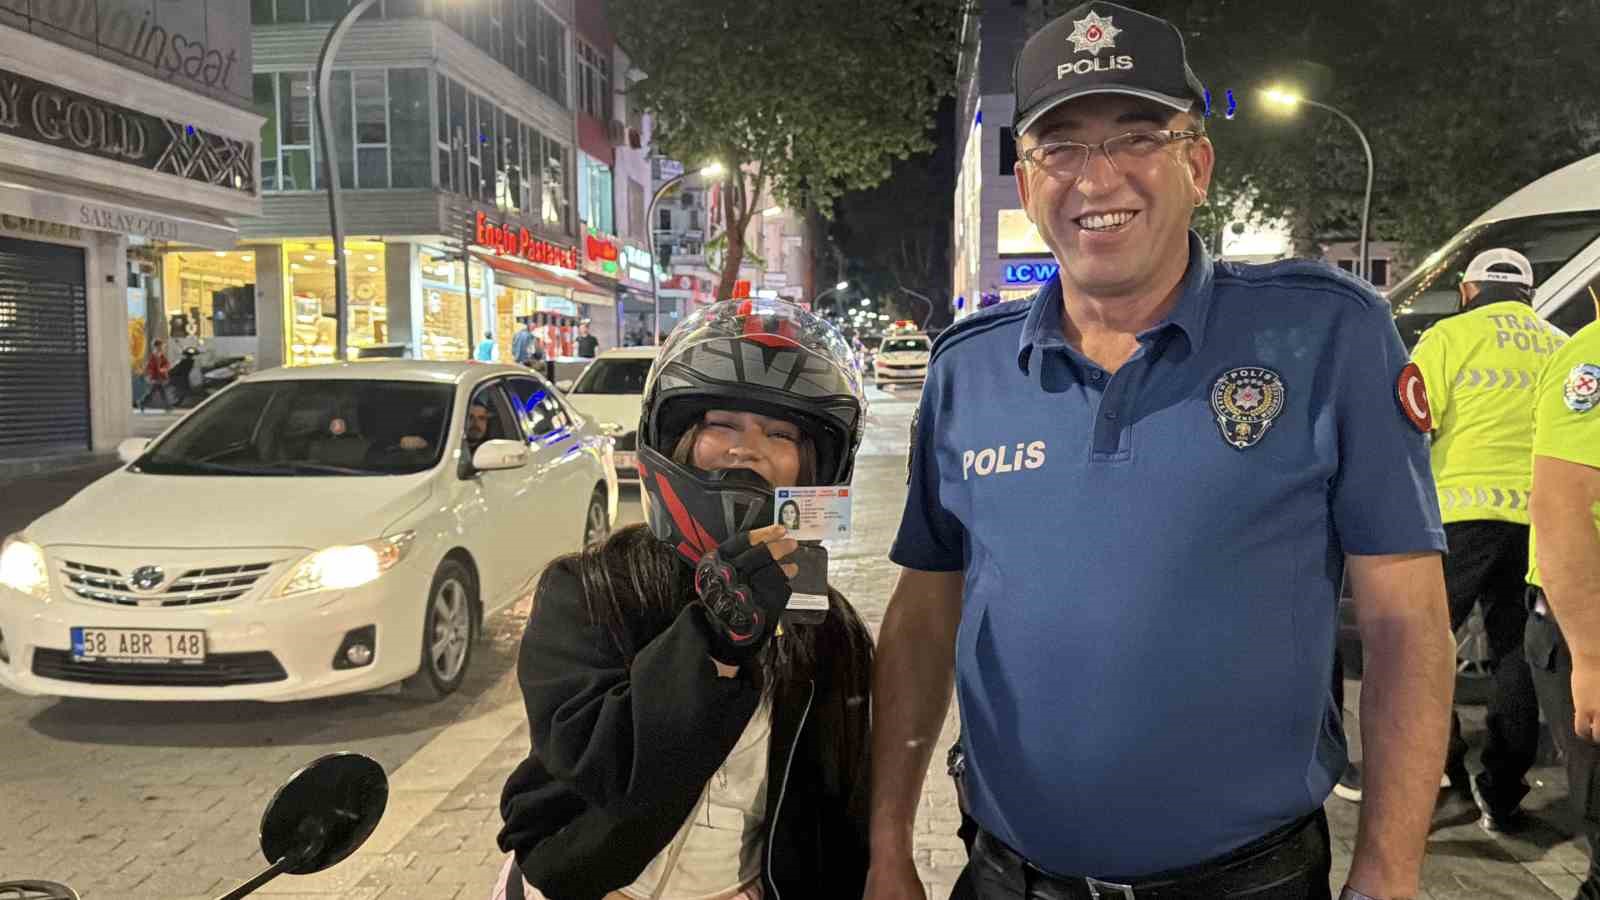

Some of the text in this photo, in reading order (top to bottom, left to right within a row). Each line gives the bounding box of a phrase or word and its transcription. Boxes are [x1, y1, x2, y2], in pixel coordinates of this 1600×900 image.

[130, 10, 238, 91] inşaat
[32, 91, 146, 159] GOLD
[84, 631, 200, 655] 58 ABR 148
